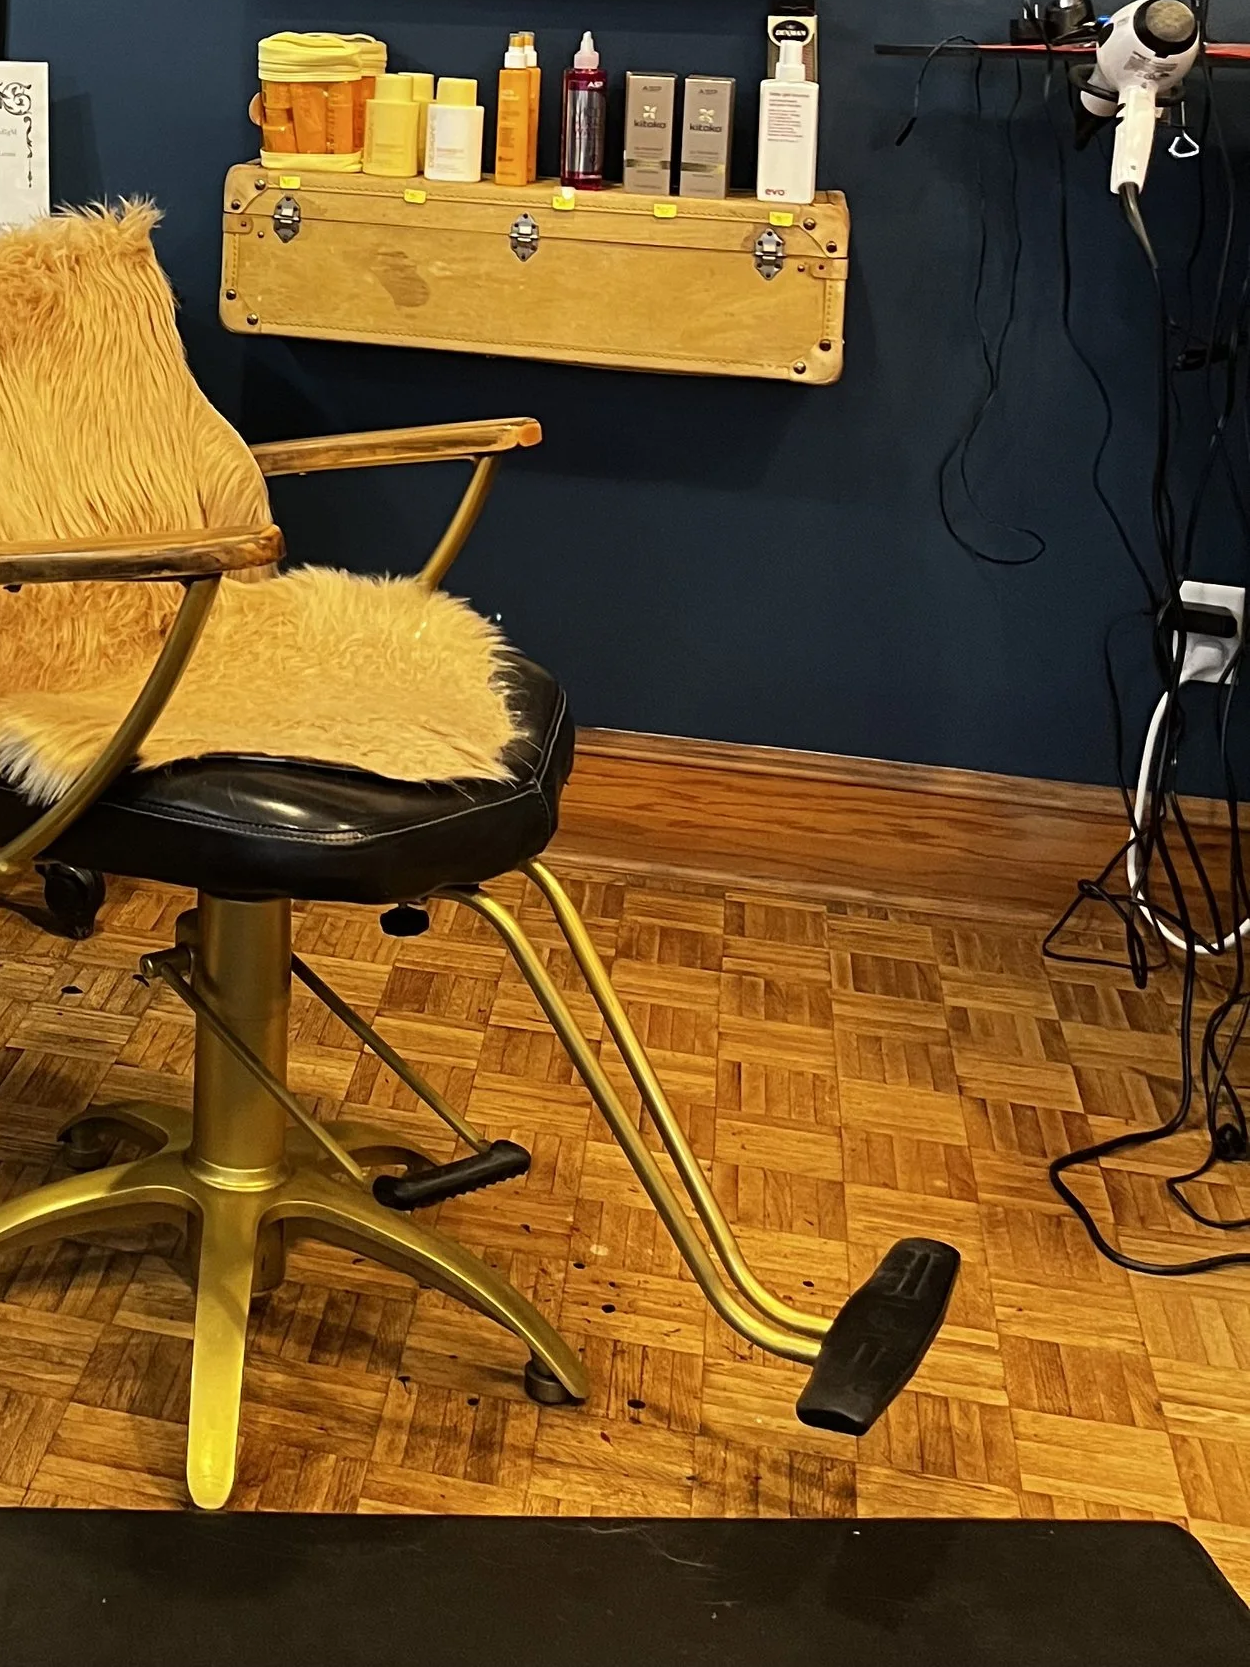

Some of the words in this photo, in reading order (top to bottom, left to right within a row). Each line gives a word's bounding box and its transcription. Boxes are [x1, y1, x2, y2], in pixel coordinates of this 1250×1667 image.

[634, 119, 666, 129] kitoko
[690, 123, 722, 133] kitoko
[765, 188, 785, 196] evo
